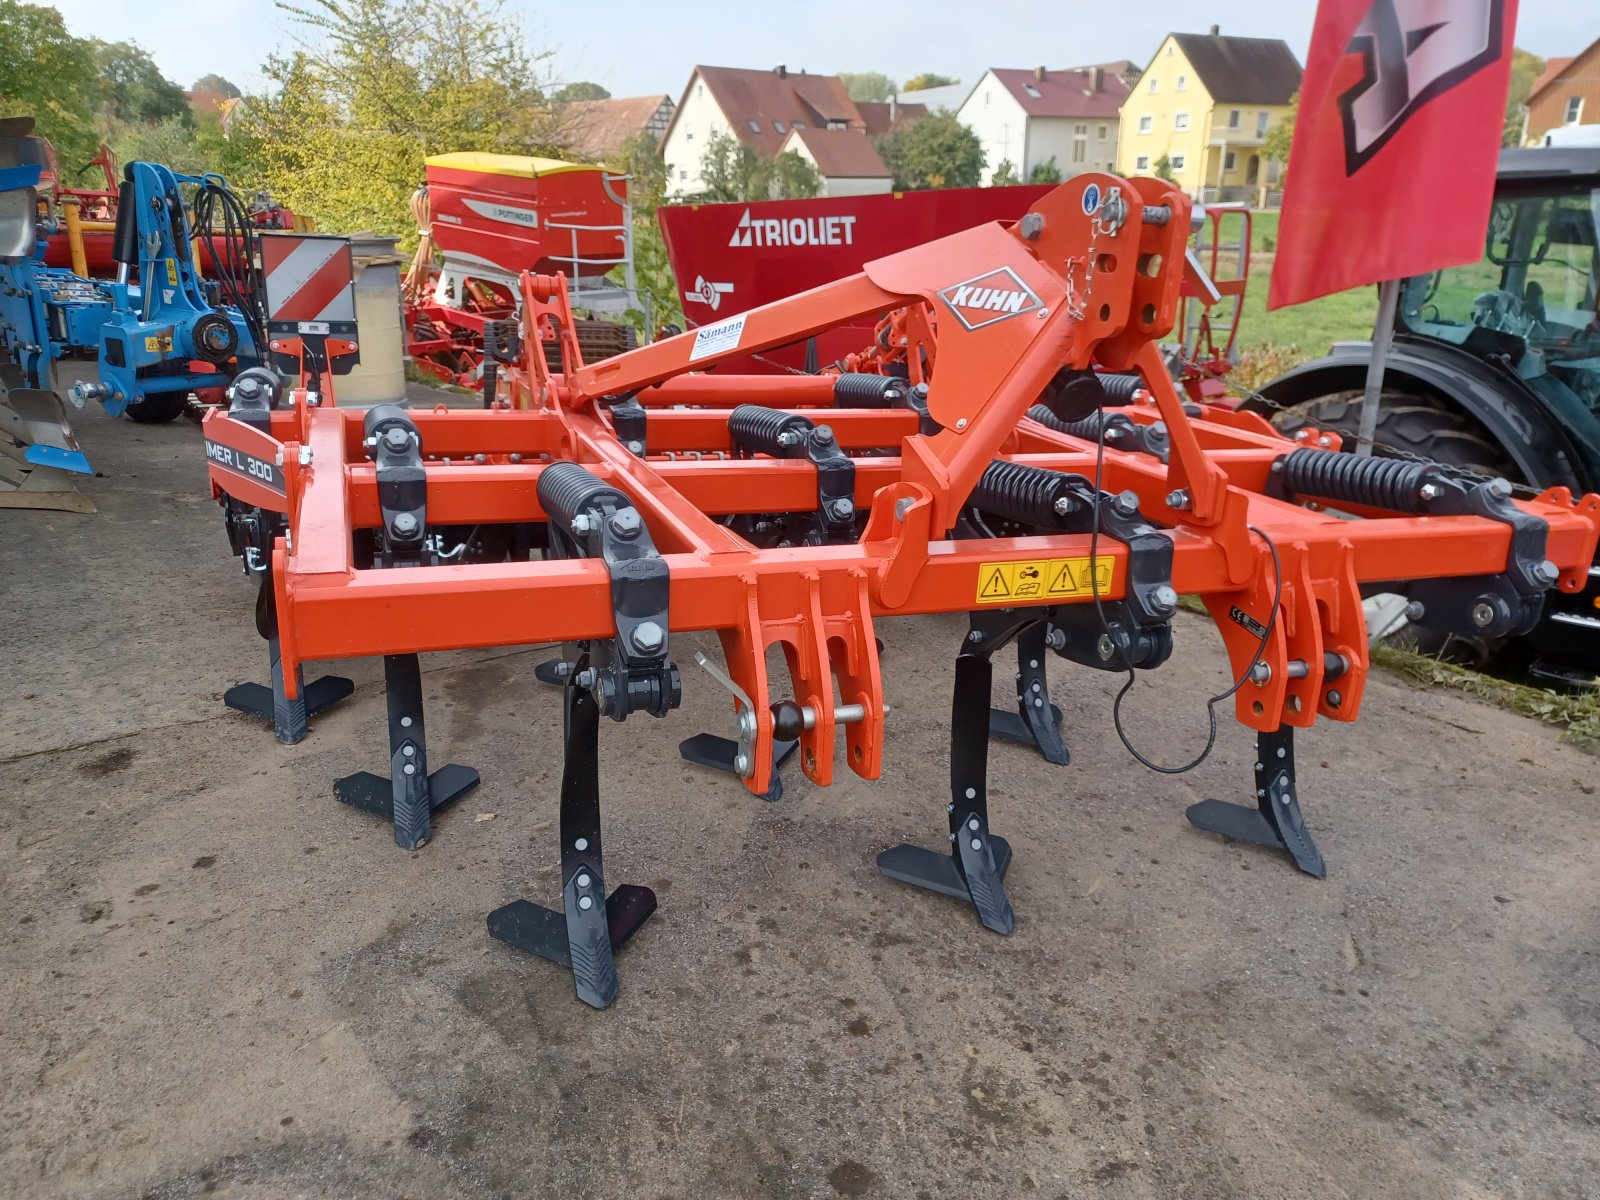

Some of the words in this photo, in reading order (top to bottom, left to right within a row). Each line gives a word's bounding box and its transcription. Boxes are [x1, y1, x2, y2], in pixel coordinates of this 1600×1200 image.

[751, 215, 856, 246] TRIOLIET
[951, 285, 1028, 313] KUHN
[204, 440, 233, 466] IMER
[236, 452, 245, 471] L
[247, 457, 272, 482] 300
